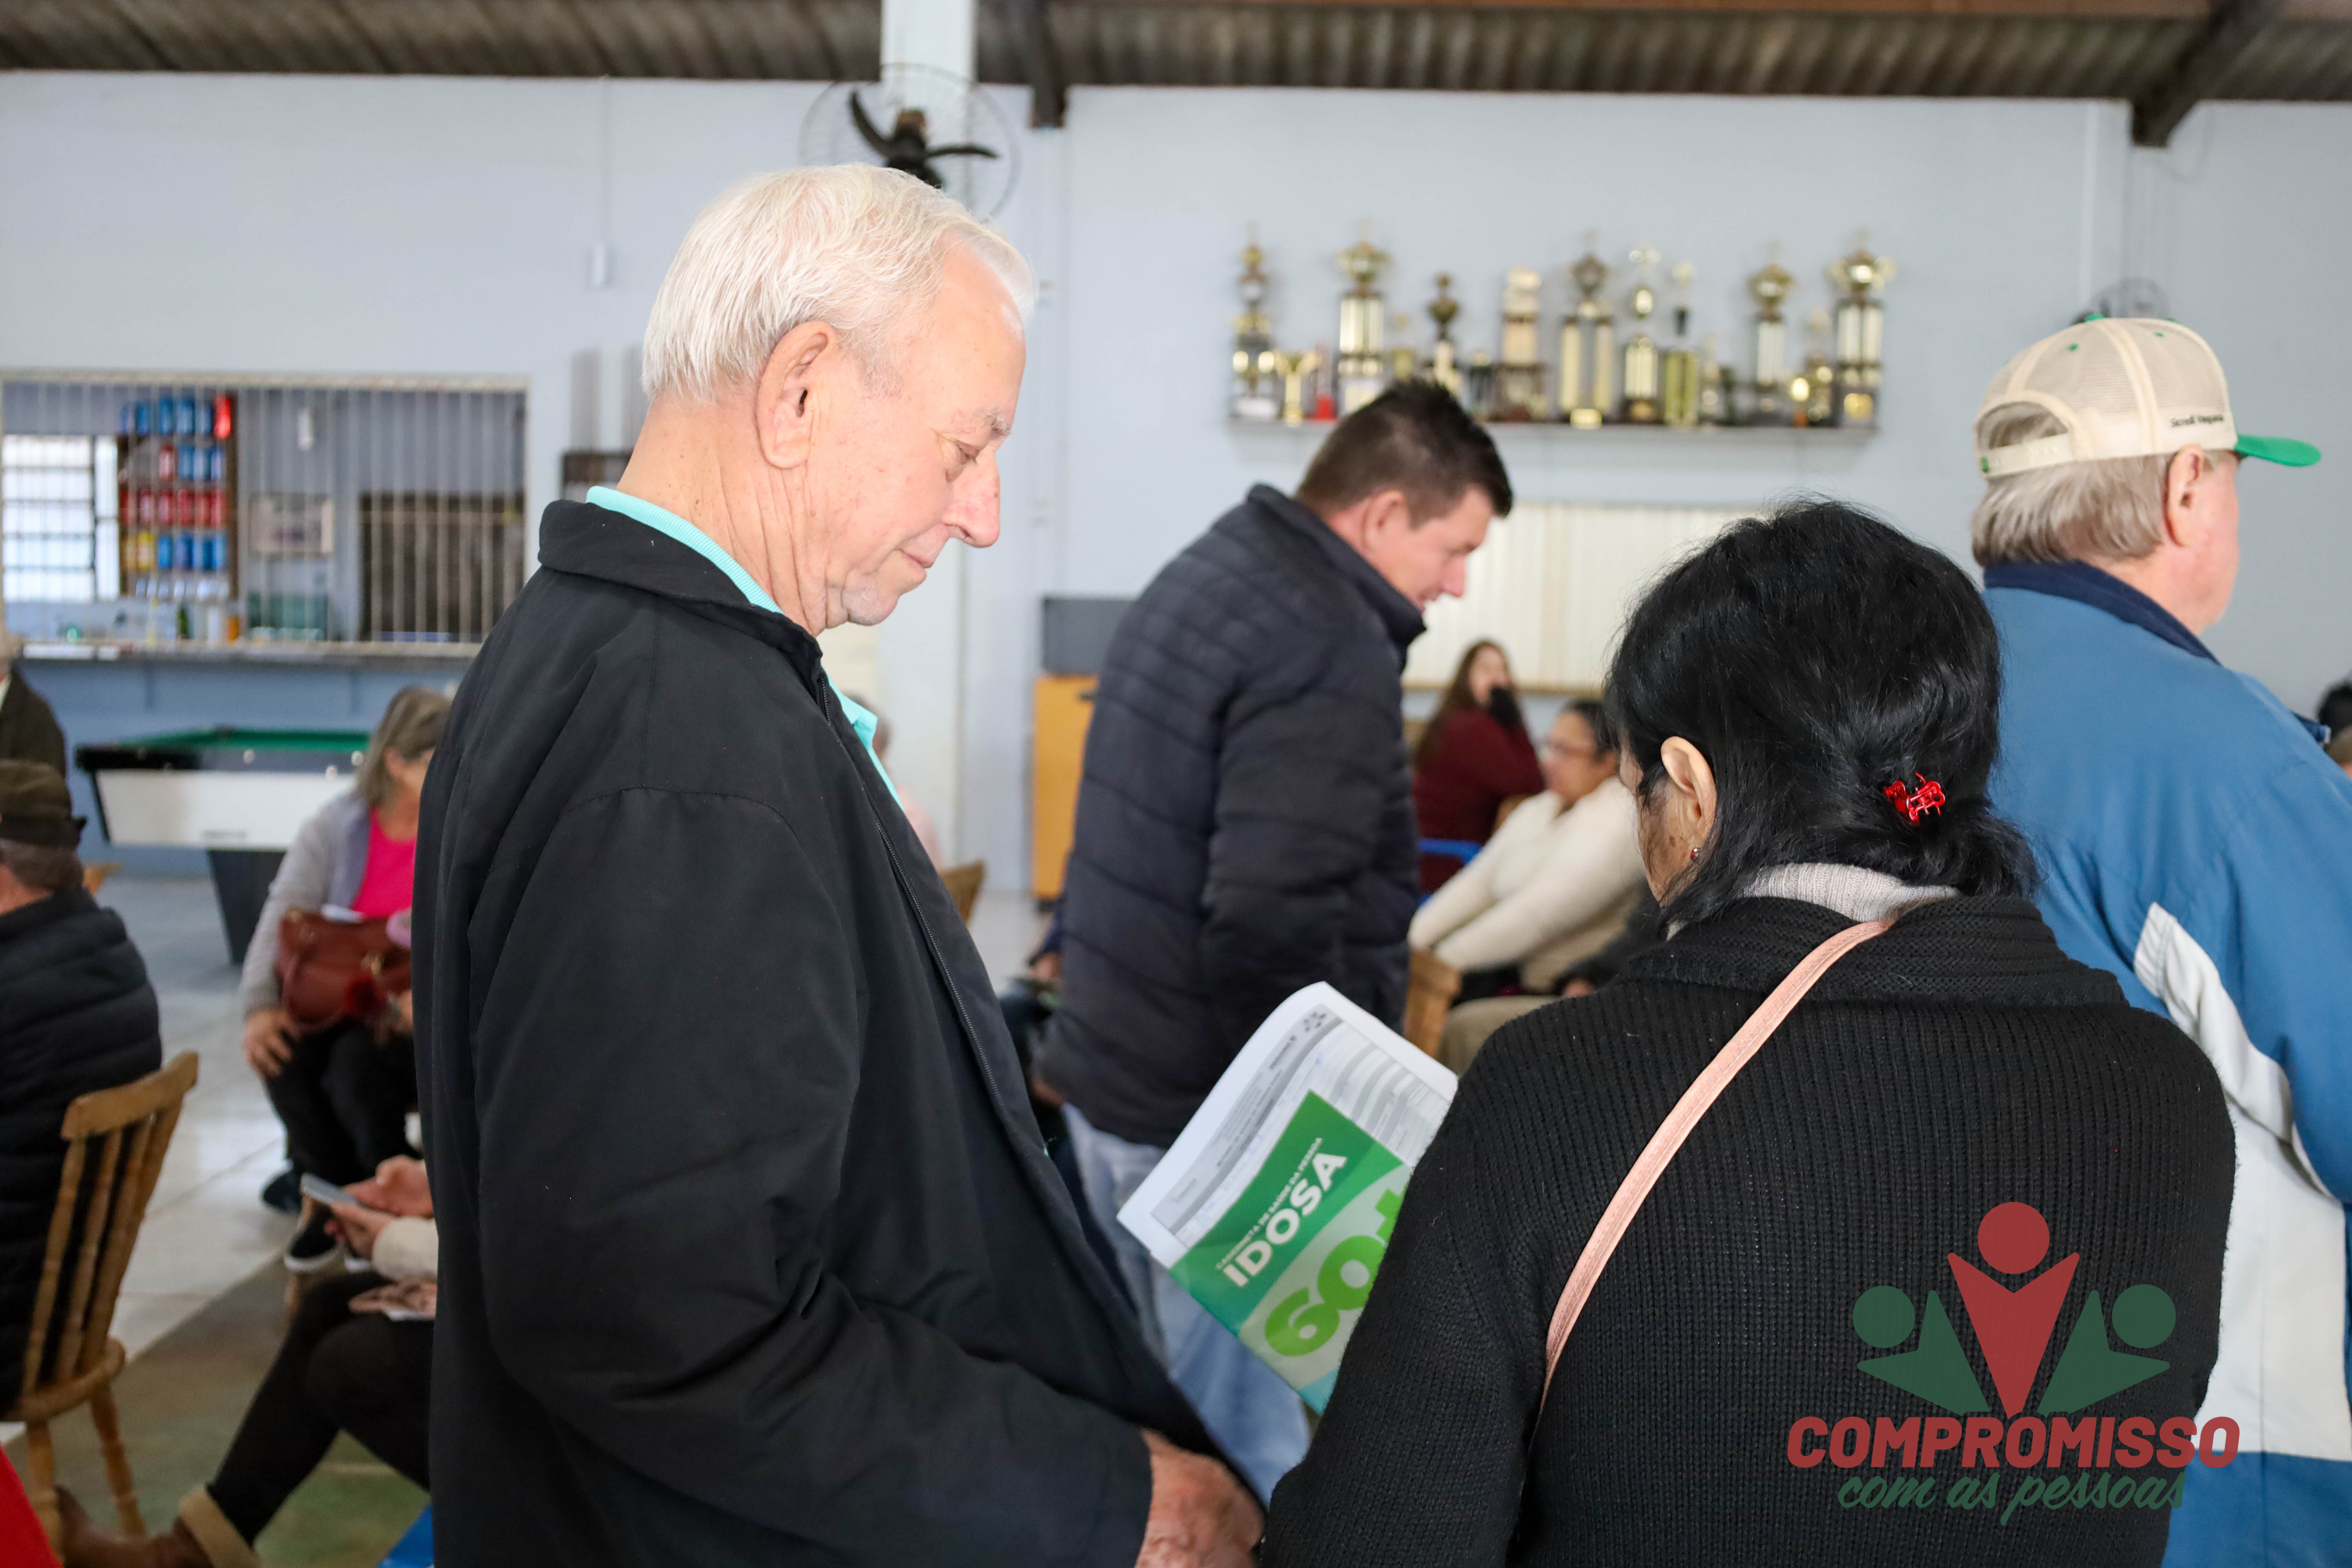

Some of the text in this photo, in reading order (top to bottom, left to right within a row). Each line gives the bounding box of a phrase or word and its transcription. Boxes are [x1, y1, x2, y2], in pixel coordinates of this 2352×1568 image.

[1223, 1152, 1348, 1286] IDOSA
[1258, 1212, 1269, 1226] DE
[1288, 1172, 1300, 1185] DA
[1297, 1138, 1323, 1171] PESSOA
